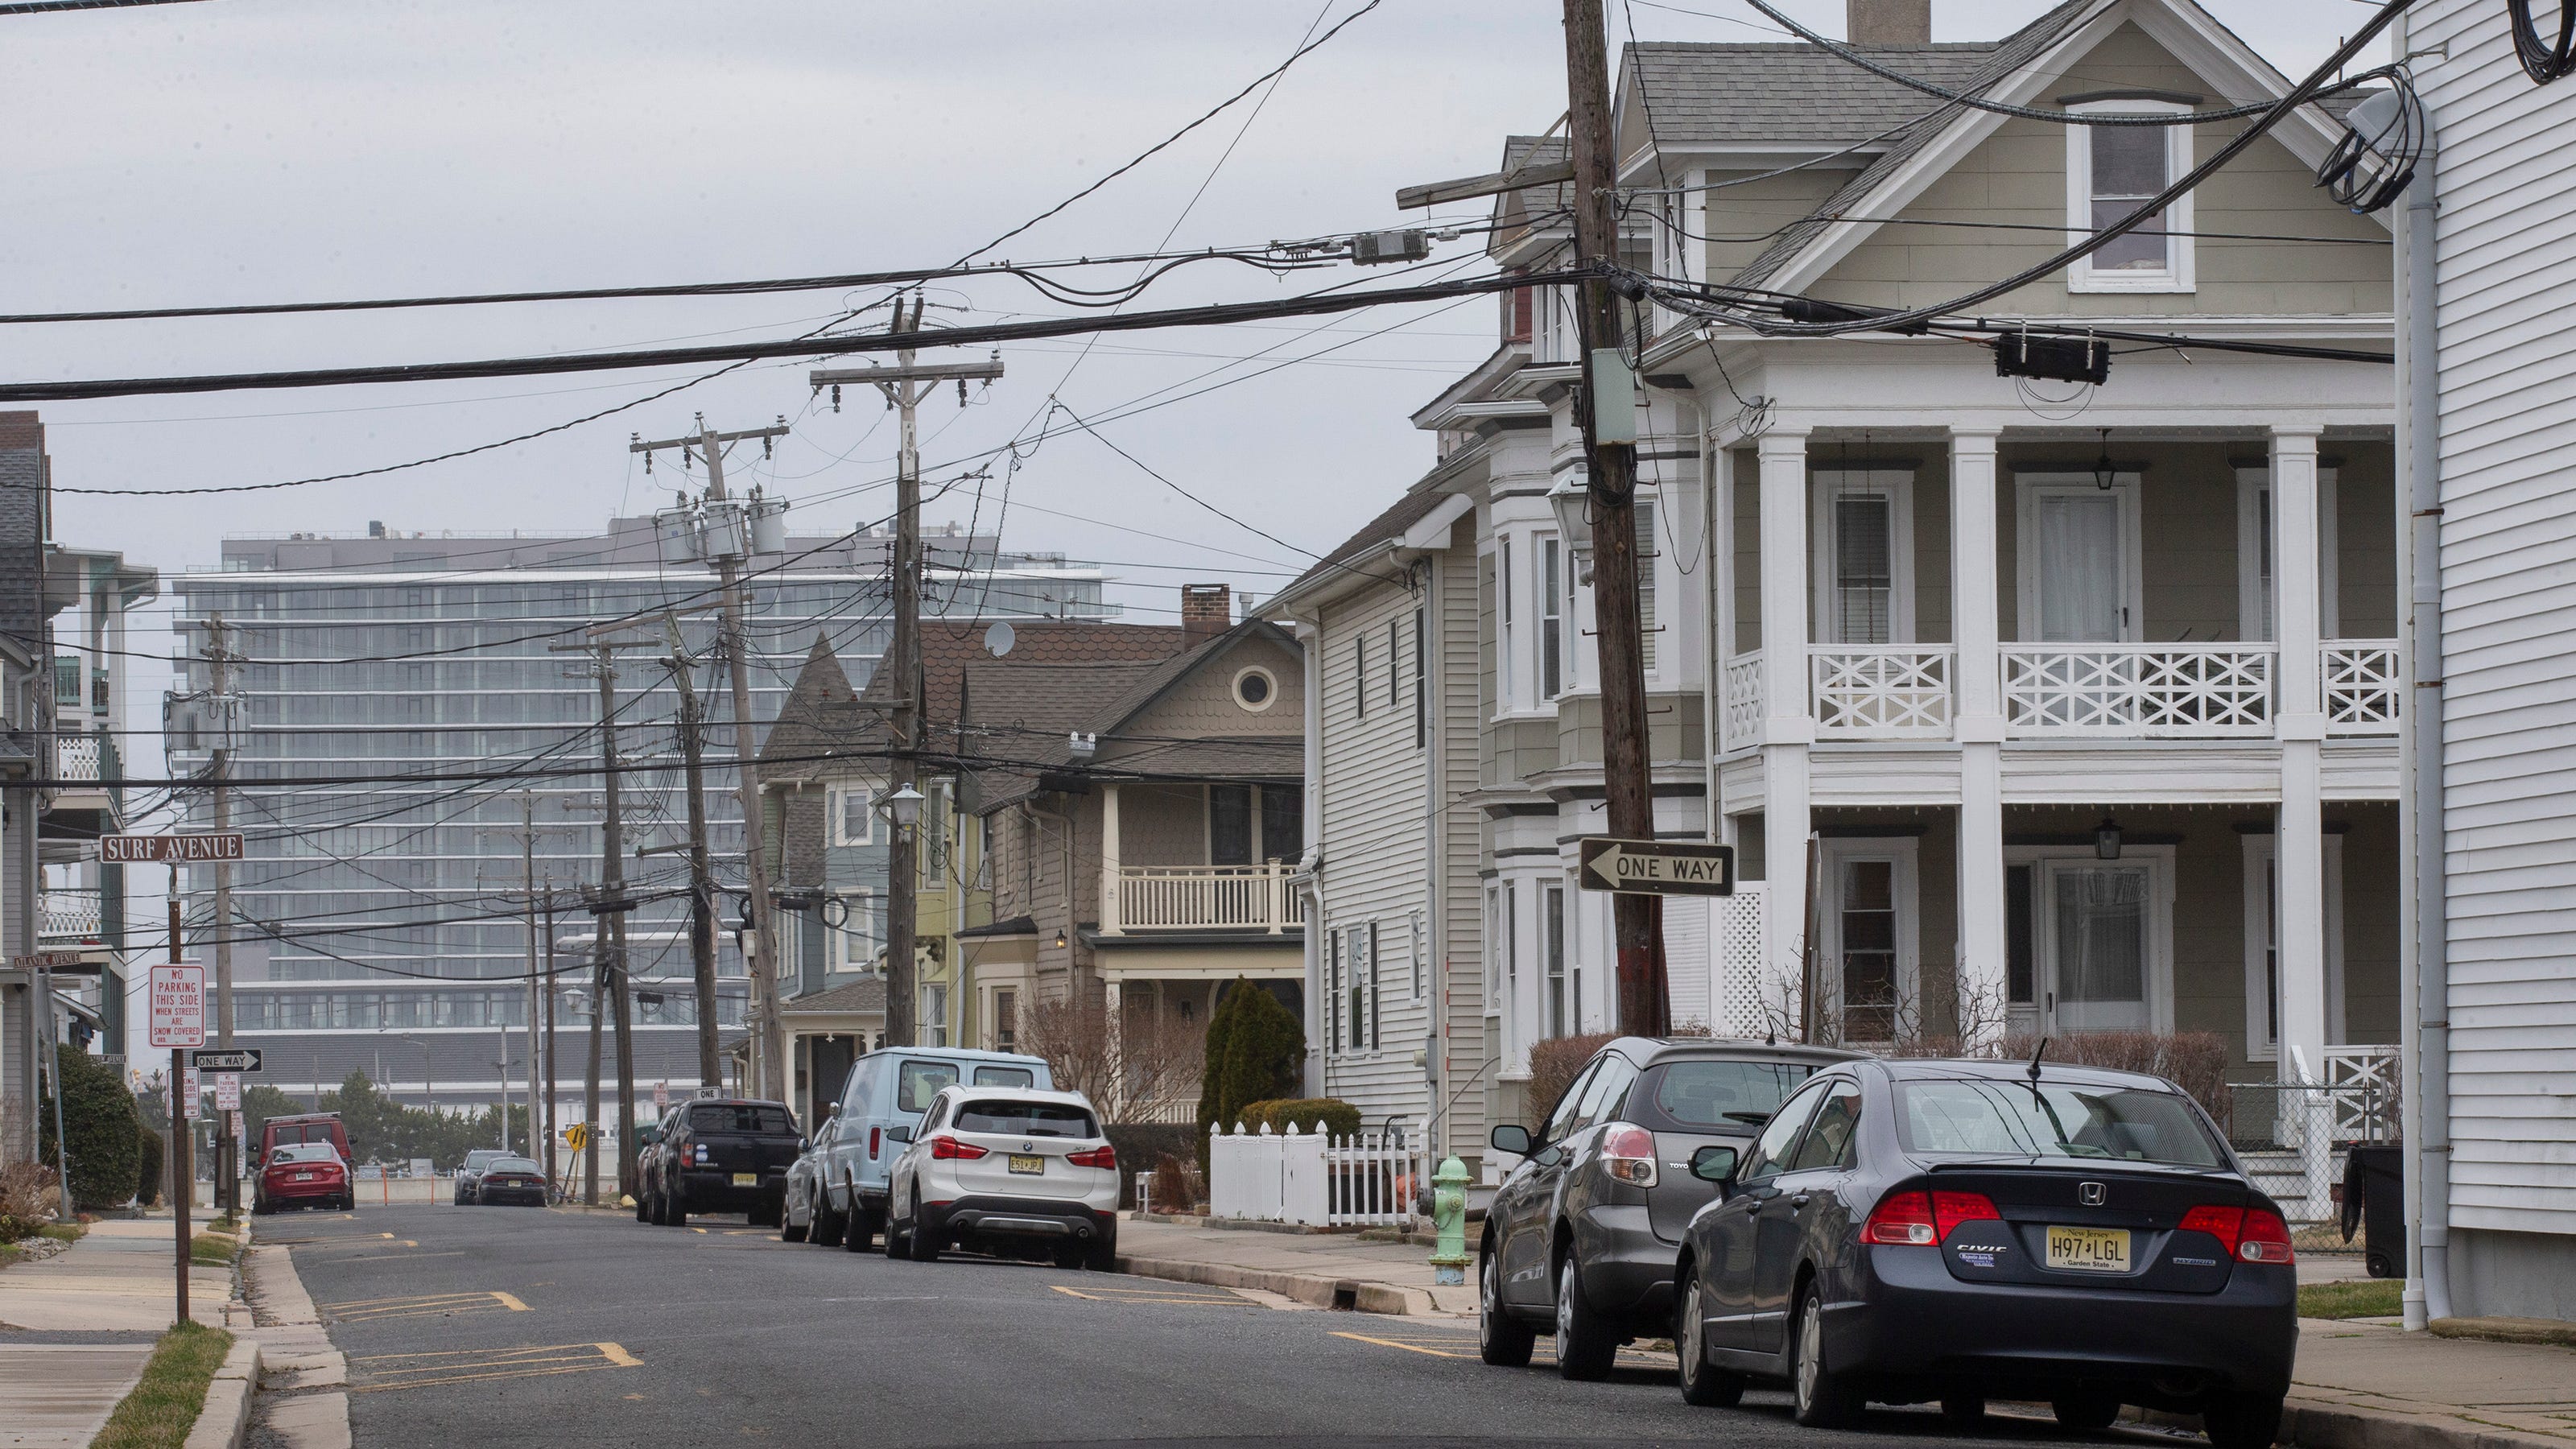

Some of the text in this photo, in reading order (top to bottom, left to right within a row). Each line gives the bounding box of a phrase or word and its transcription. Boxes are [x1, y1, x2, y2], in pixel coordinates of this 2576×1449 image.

[108, 837, 237, 859] SURF AVENUE
[1616, 857, 1718, 880] ONE WAY
[16, 952, 78, 968] ATLANTIC AVENUE
[171, 969, 183, 980] NO
[159, 982, 196, 993] PARKING
[156, 995, 198, 1005] THIS SIDE
[174, 1027, 200, 1035] COVERED
[198, 1056, 245, 1066] ONE WAY
[700, 1090, 714, 1098] ONE
[1011, 1160, 1024, 1169] E51
[2067, 1228, 2109, 1238] New Jersey
[2052, 1237, 2124, 1261] H97 LGL
